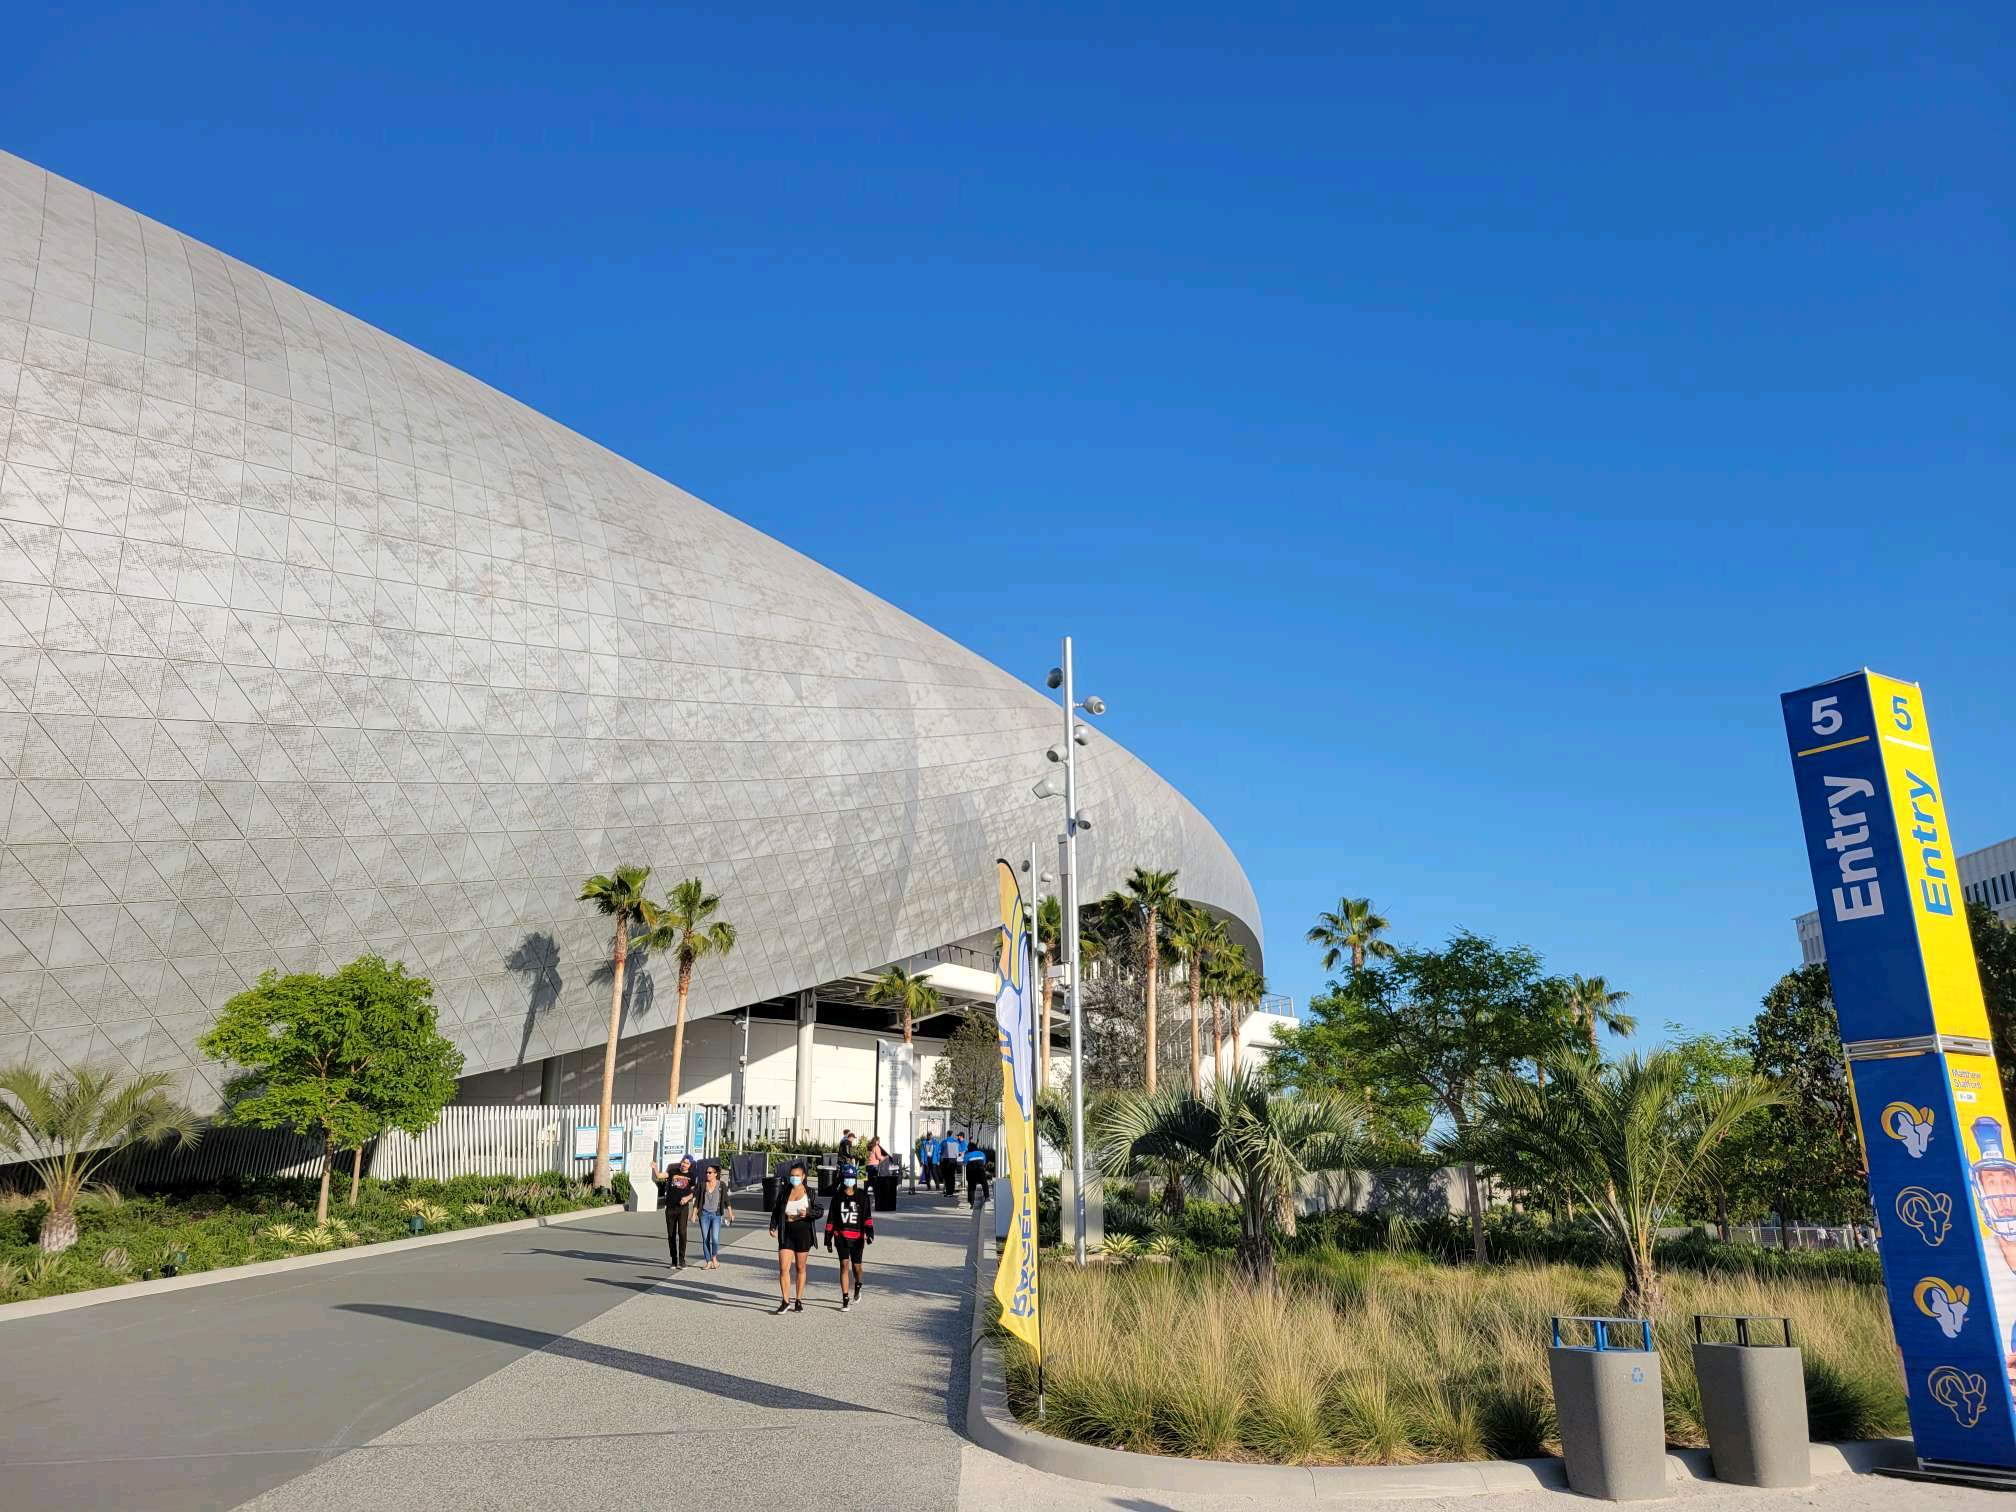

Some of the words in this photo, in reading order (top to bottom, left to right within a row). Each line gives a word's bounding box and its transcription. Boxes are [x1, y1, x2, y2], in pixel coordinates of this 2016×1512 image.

[1811, 696, 1843, 736] 5
[1892, 695, 1913, 732] 5
[1823, 775, 1885, 922] Entry
[1905, 769, 1954, 917] Entry
